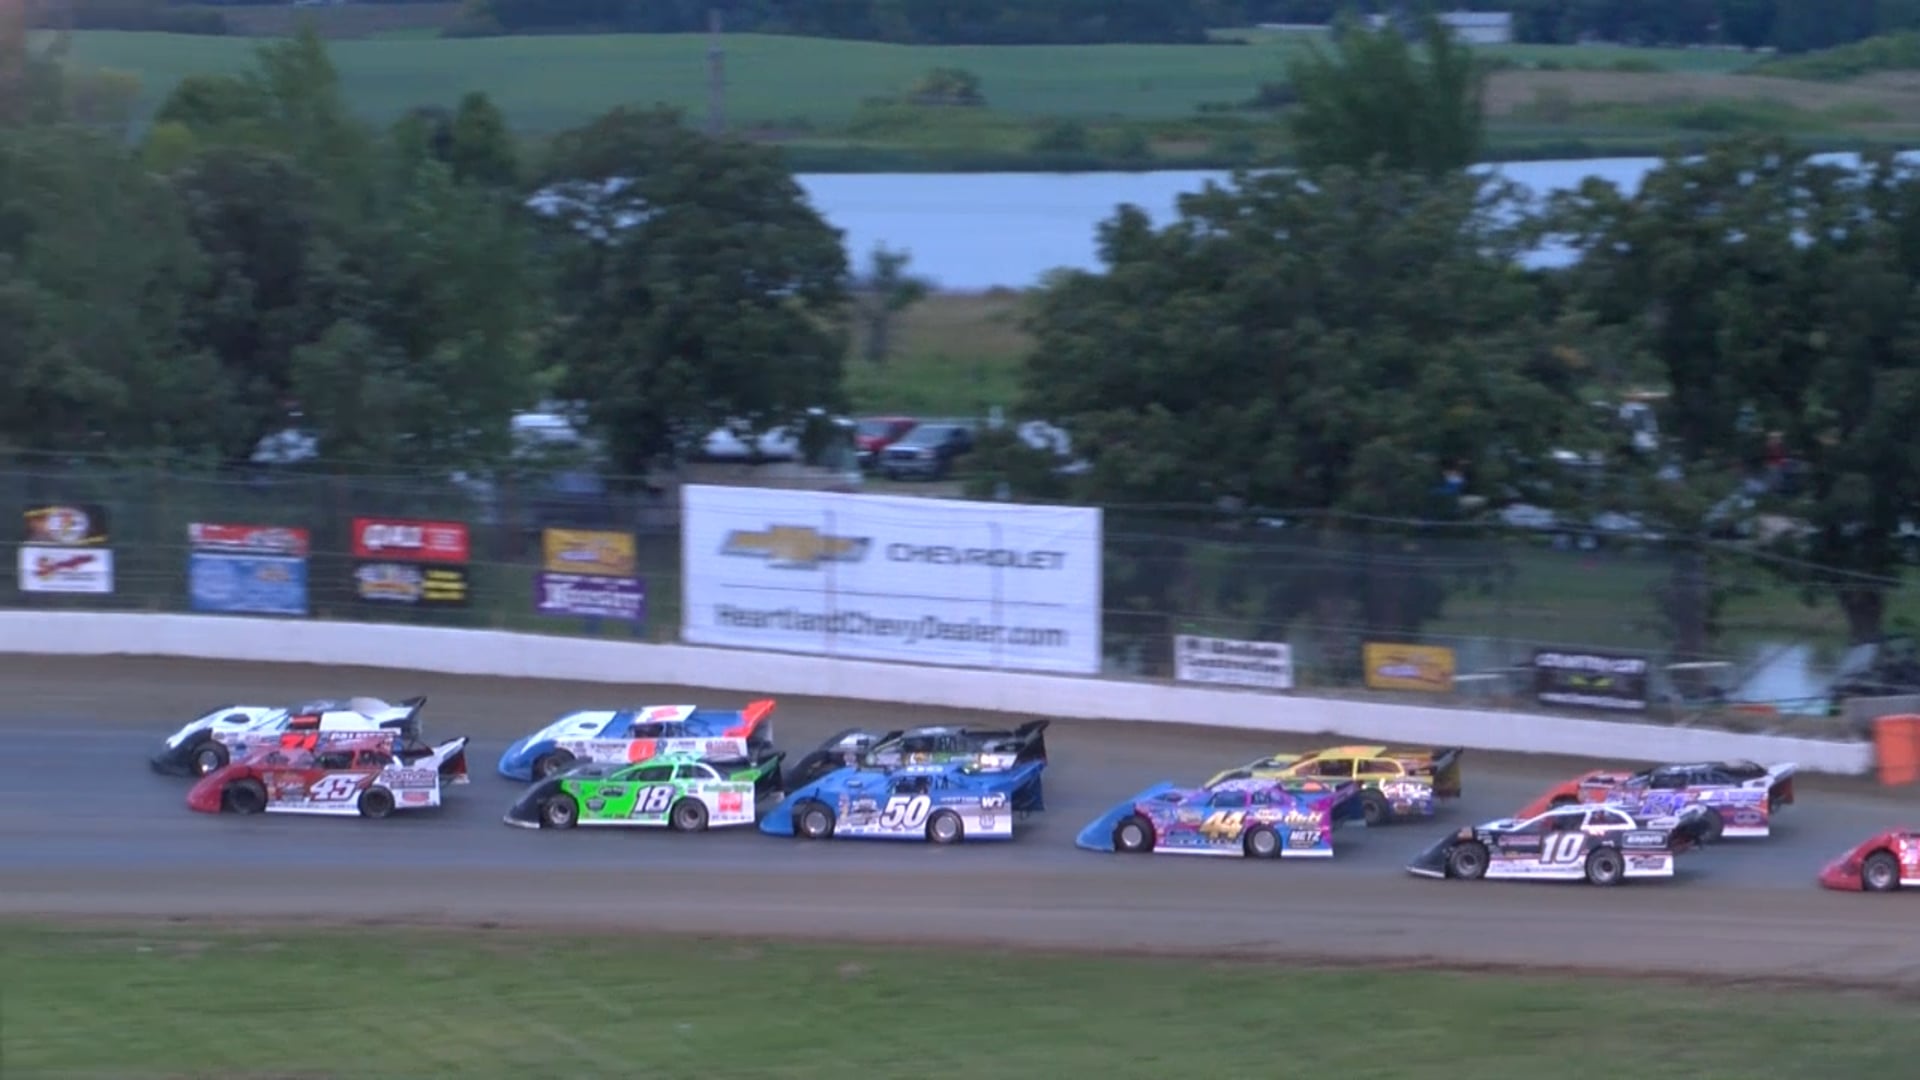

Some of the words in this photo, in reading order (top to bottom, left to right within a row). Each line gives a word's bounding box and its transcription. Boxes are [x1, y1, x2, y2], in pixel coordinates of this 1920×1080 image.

[886, 543, 1066, 569] CHEVROLET
[310, 774, 366, 802] 45
[632, 785, 675, 814] 18
[880, 795, 932, 829] 50
[1200, 810, 1248, 839] 44
[1540, 833, 1585, 863] 10
